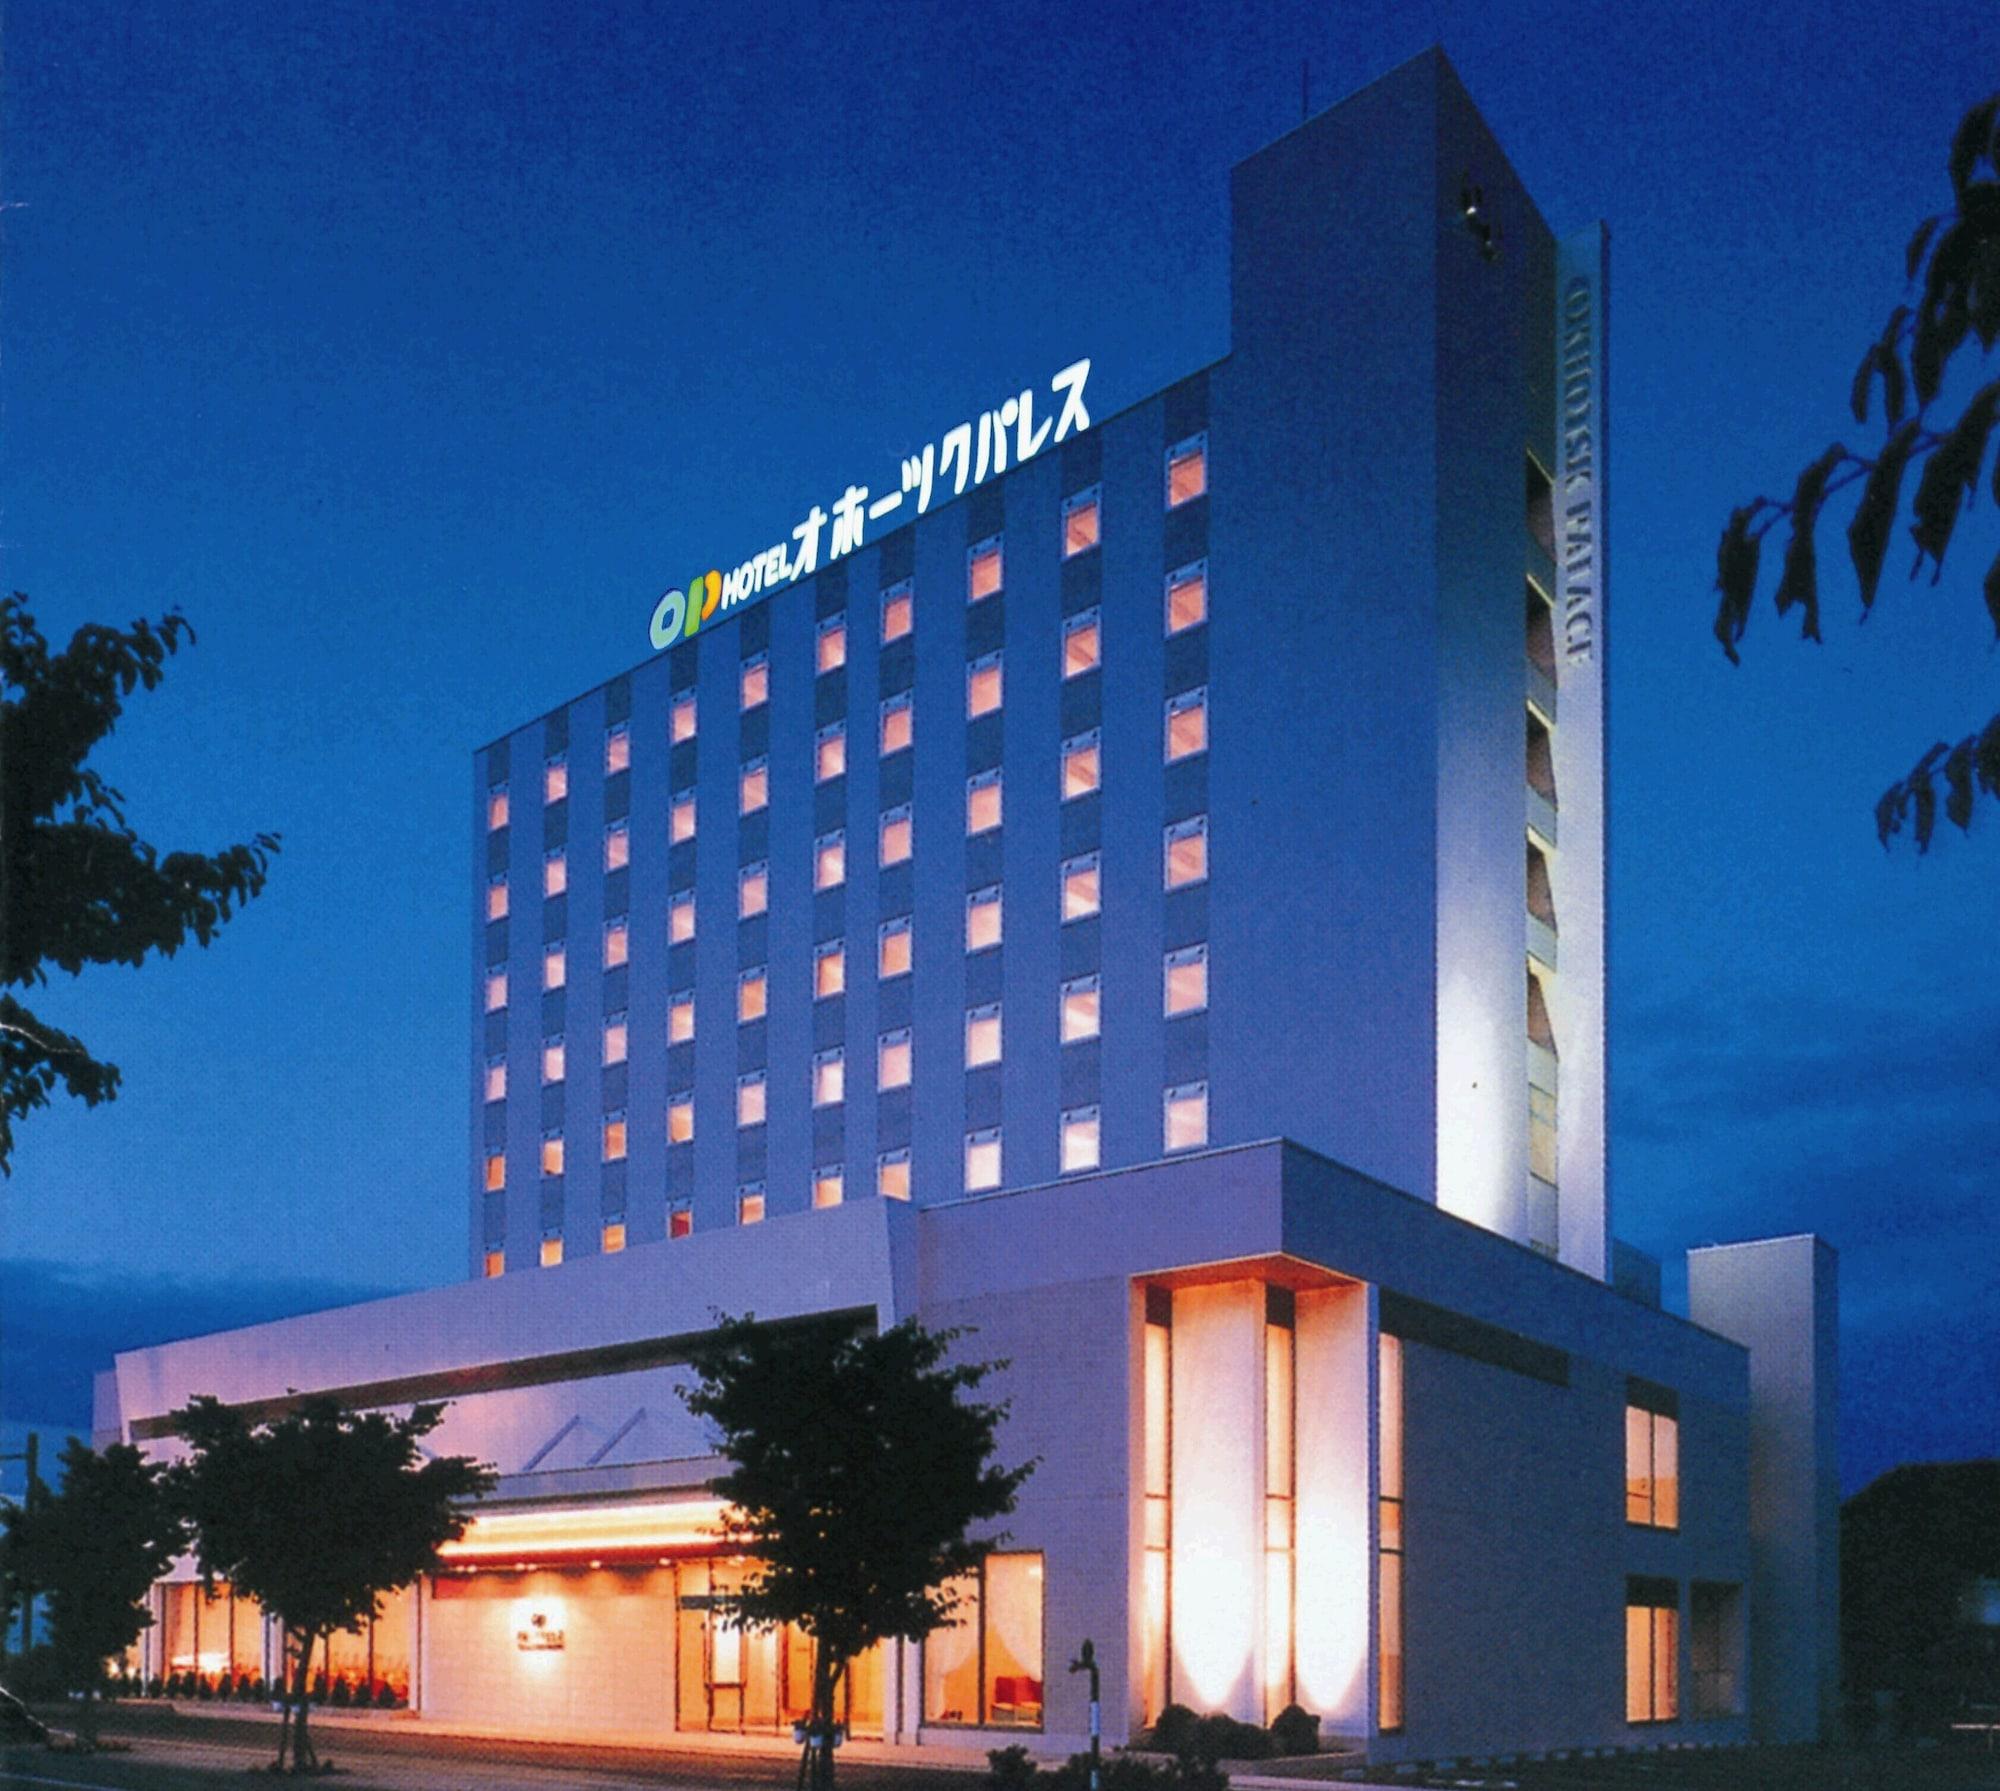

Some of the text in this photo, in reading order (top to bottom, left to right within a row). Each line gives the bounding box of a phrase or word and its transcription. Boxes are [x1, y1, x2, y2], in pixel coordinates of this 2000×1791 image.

[721, 542, 793, 610] HOTEL
[789, 357, 1092, 582] オホーツクパレス
